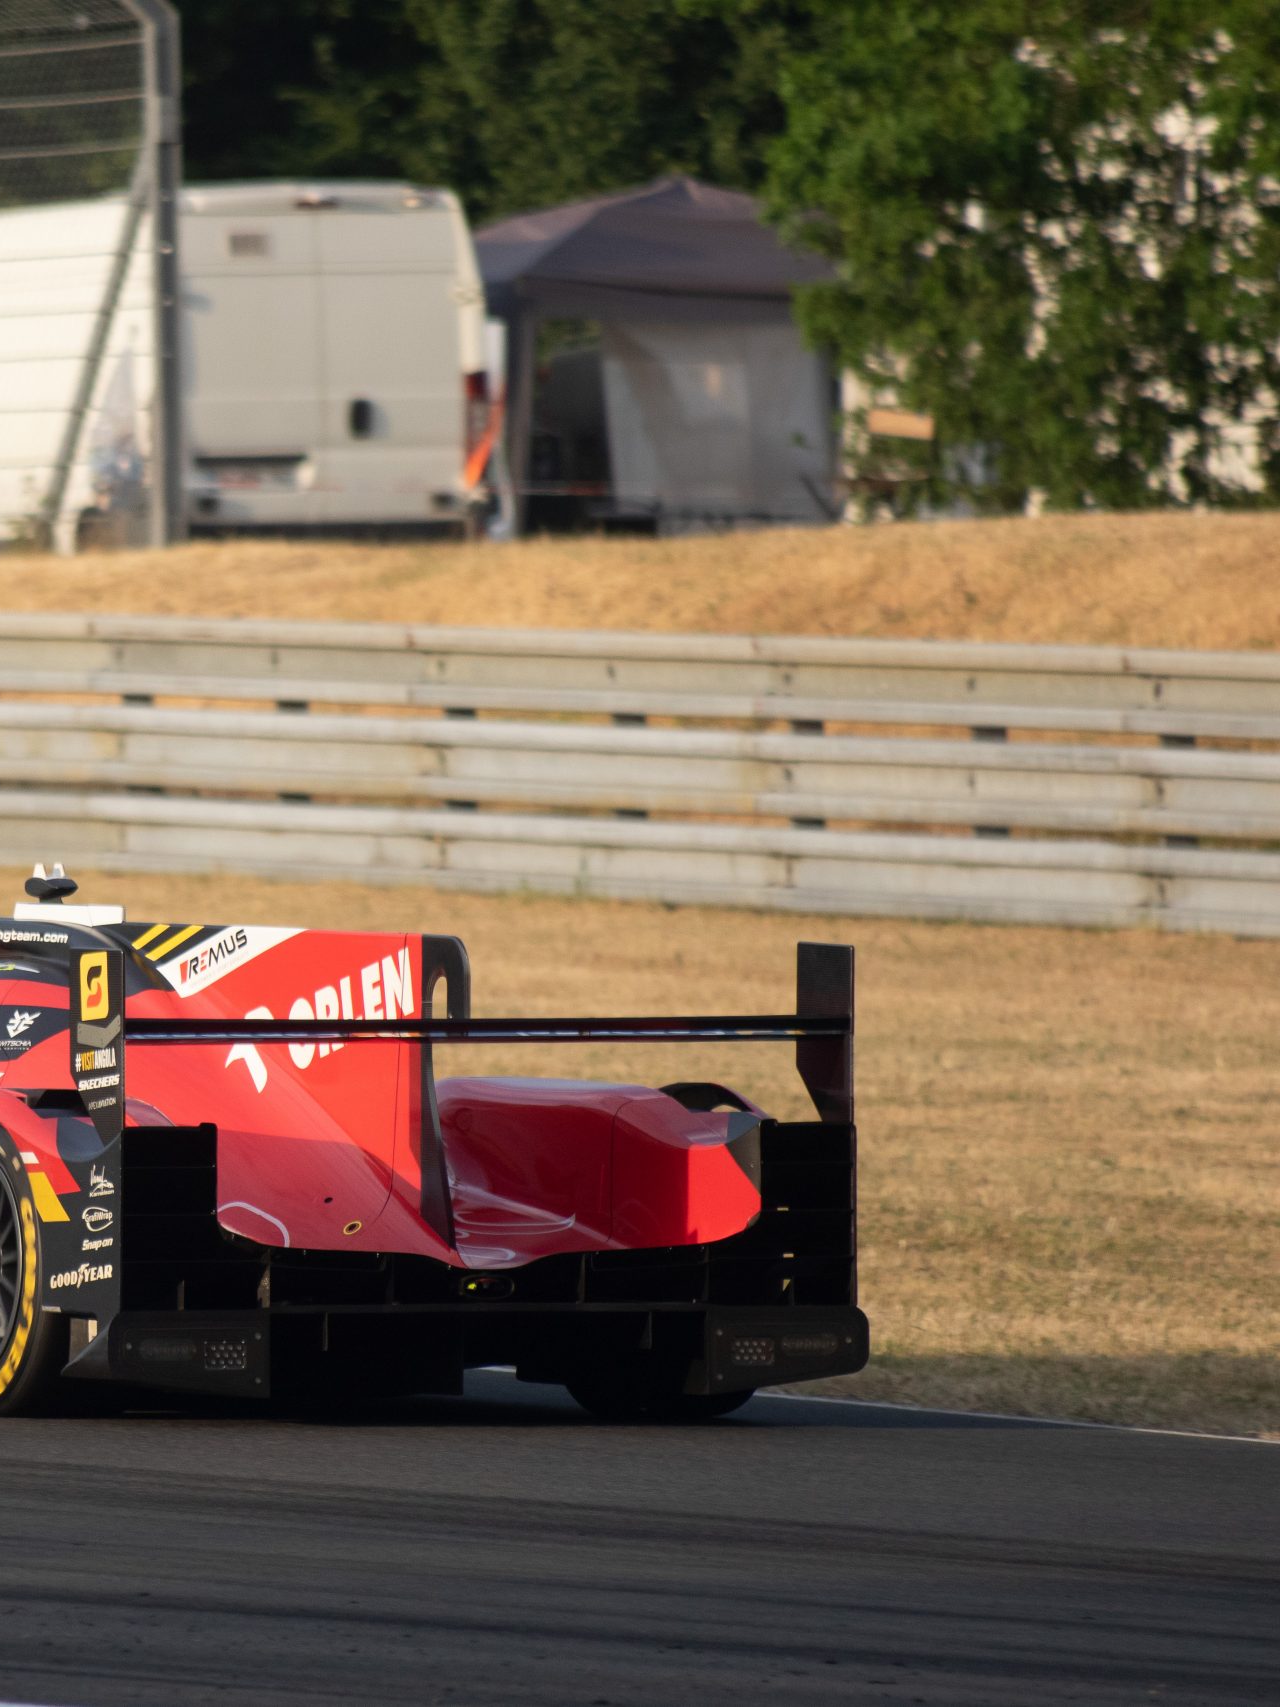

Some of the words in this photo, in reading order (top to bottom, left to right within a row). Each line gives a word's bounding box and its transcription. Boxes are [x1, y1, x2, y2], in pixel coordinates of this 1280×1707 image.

[188, 929, 248, 980] REMUS
[287, 947, 415, 1070] ORLEN
[75, 1048, 117, 1073] #VISITANGOLA
[78, 1074, 121, 1092] SKECHERS
[50, 1262, 114, 1289] GOODYEAR
